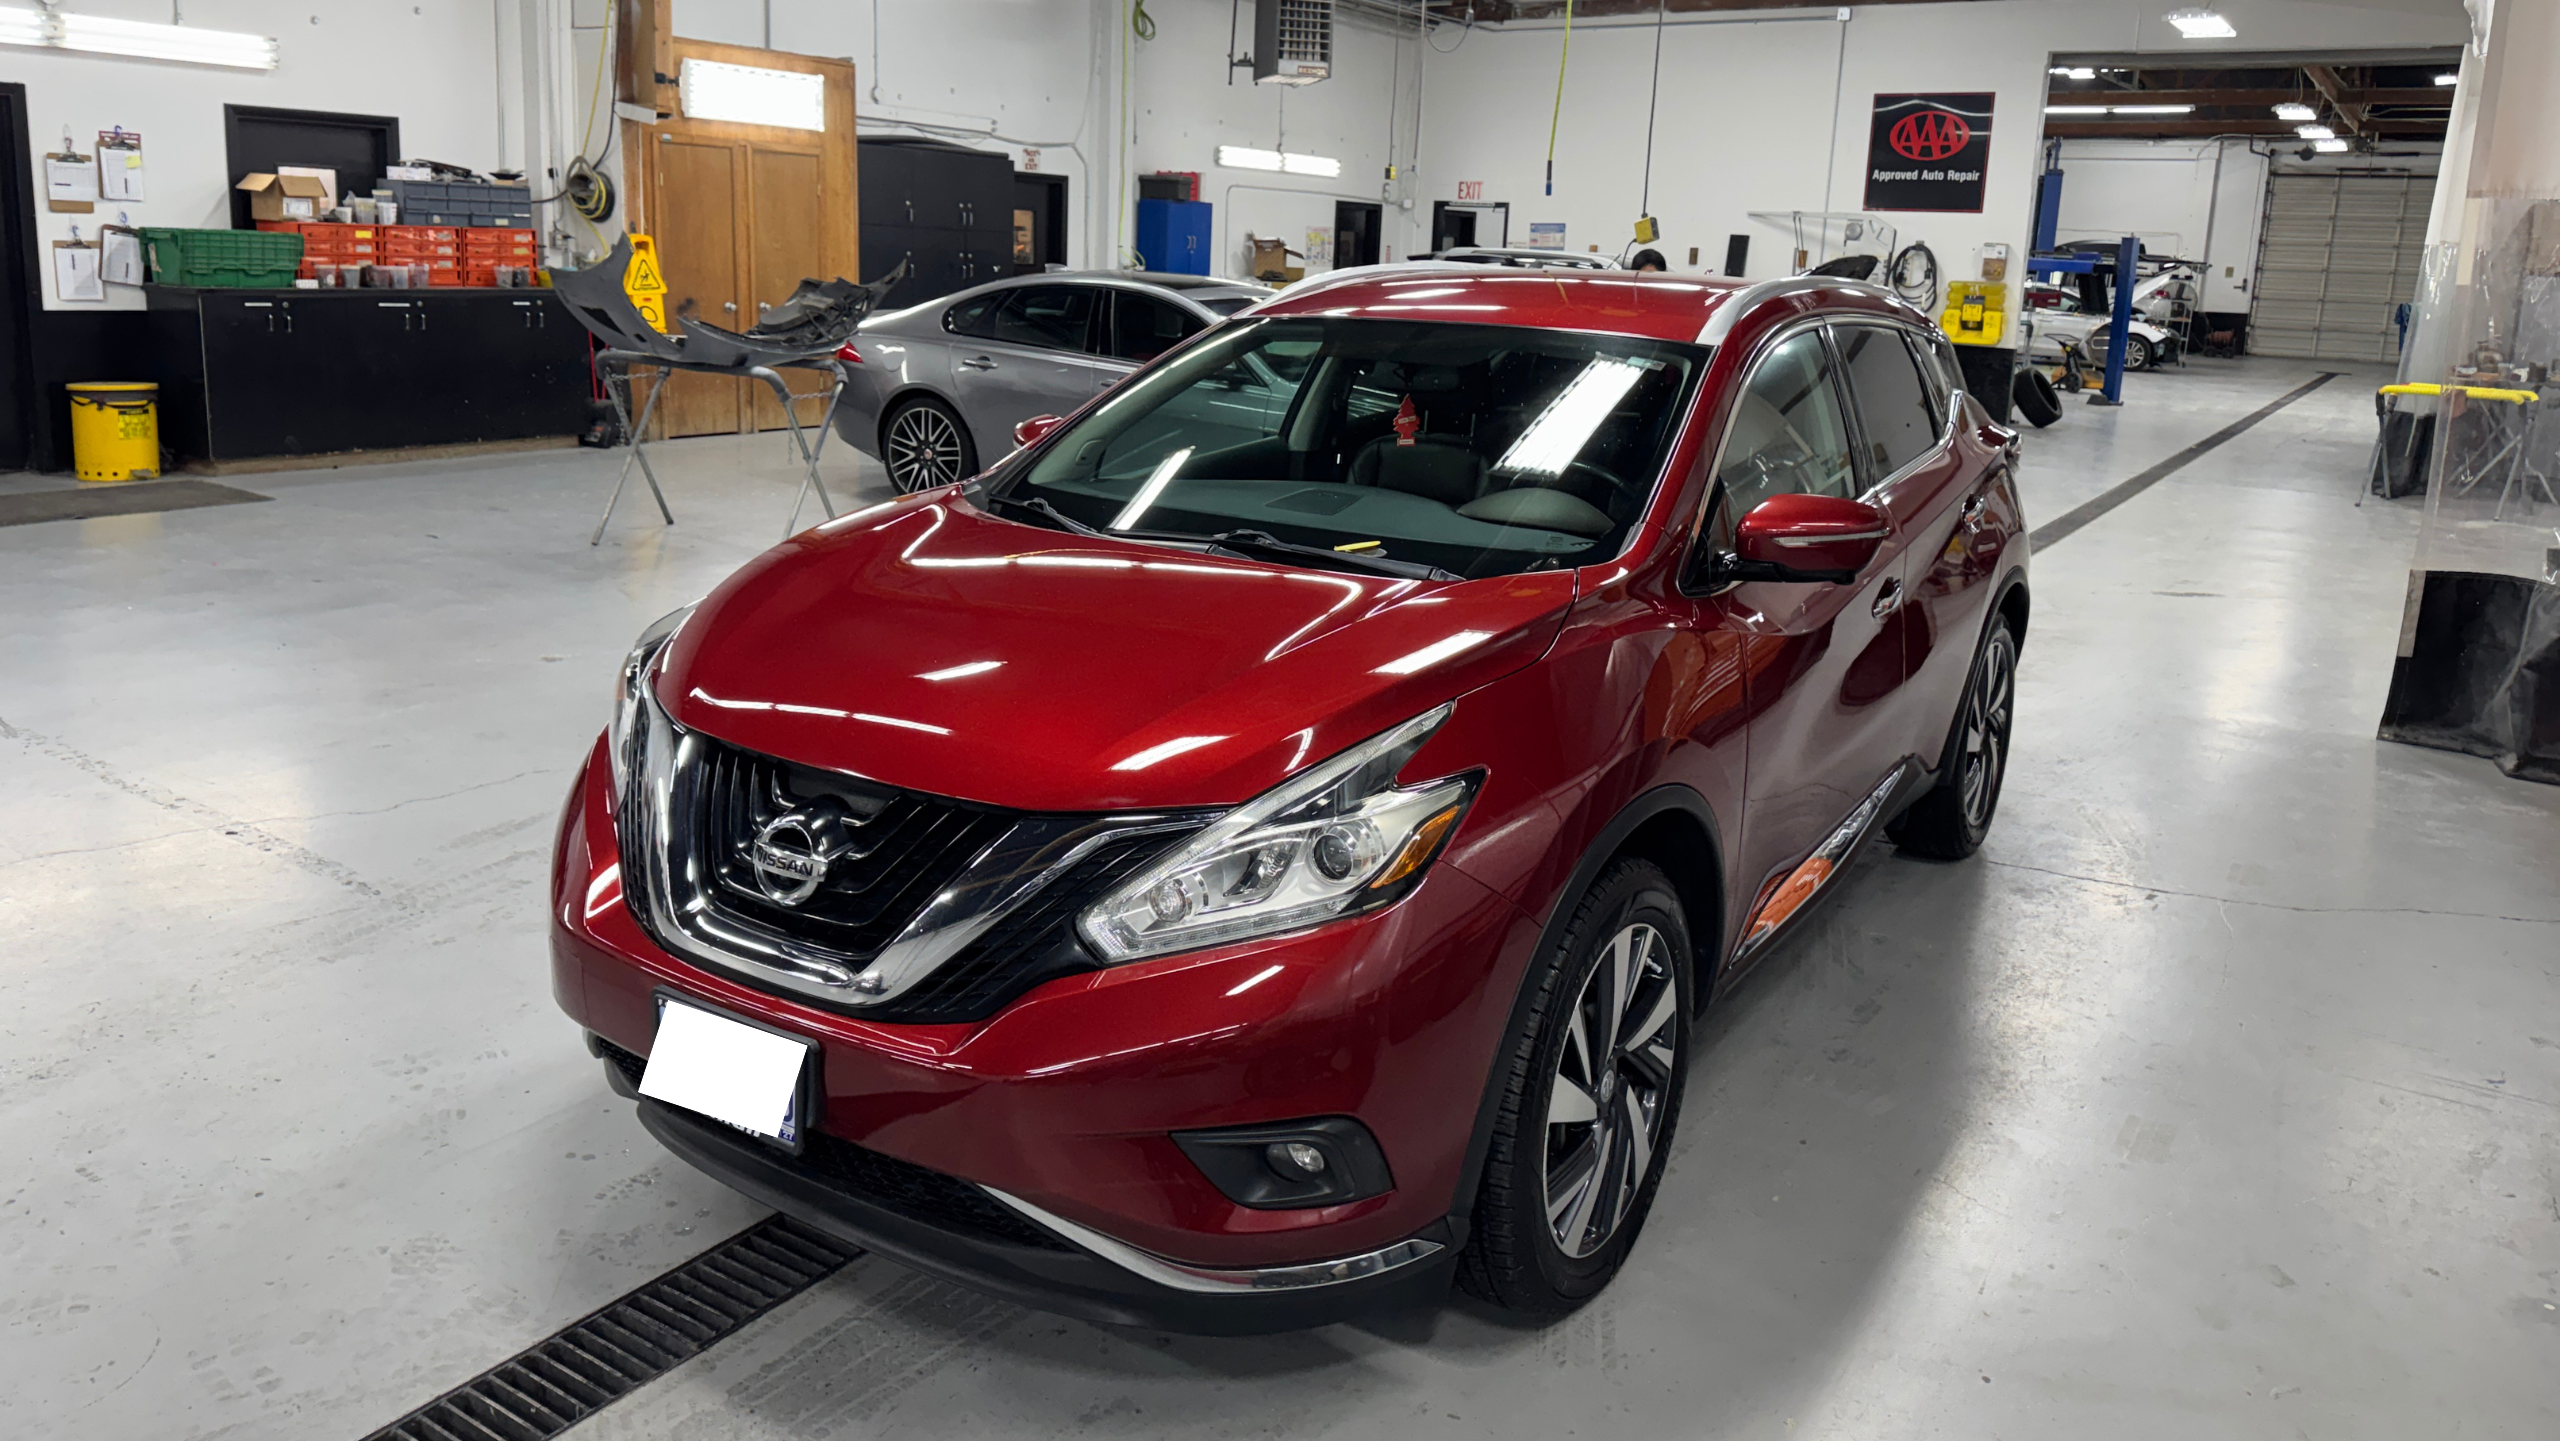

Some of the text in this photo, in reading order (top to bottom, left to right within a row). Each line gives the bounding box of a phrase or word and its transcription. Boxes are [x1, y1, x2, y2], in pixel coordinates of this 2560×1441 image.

[1893, 112, 1966, 159] AAA
[1872, 169, 1980, 183] Approved Auto Repair
[1457, 181, 1483, 200] EXIT
[756, 847, 814, 877] NISSAN
